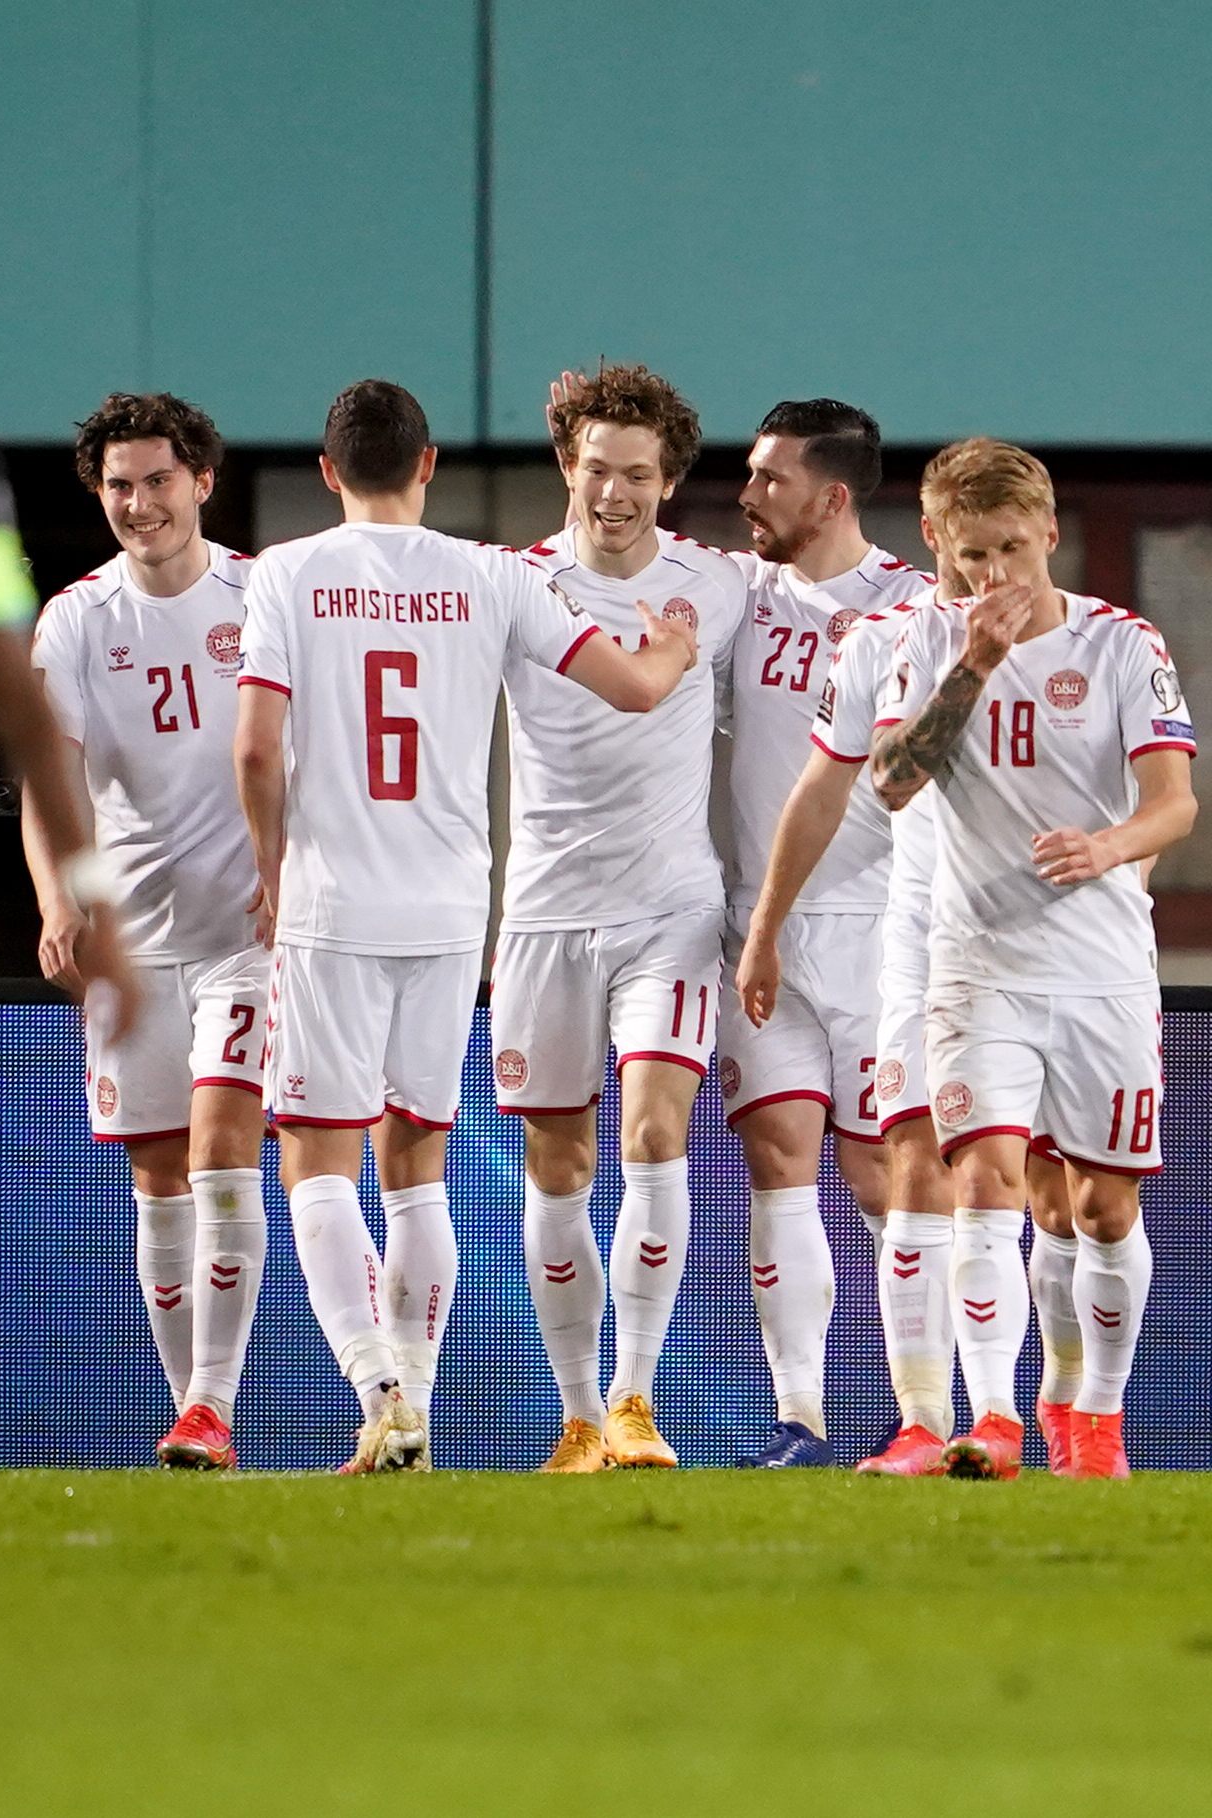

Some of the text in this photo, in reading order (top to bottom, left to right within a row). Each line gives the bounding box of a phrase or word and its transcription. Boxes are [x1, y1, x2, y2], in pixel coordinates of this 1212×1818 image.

[313, 587, 470, 623] CHRISTENSEN
[761, 626, 819, 692] 23
[147, 664, 200, 733] 21
[363, 650, 419, 801] 6
[988, 700, 1035, 767] 18
[671, 979, 708, 1046] 11
[1108, 1088, 1154, 1154] 18
